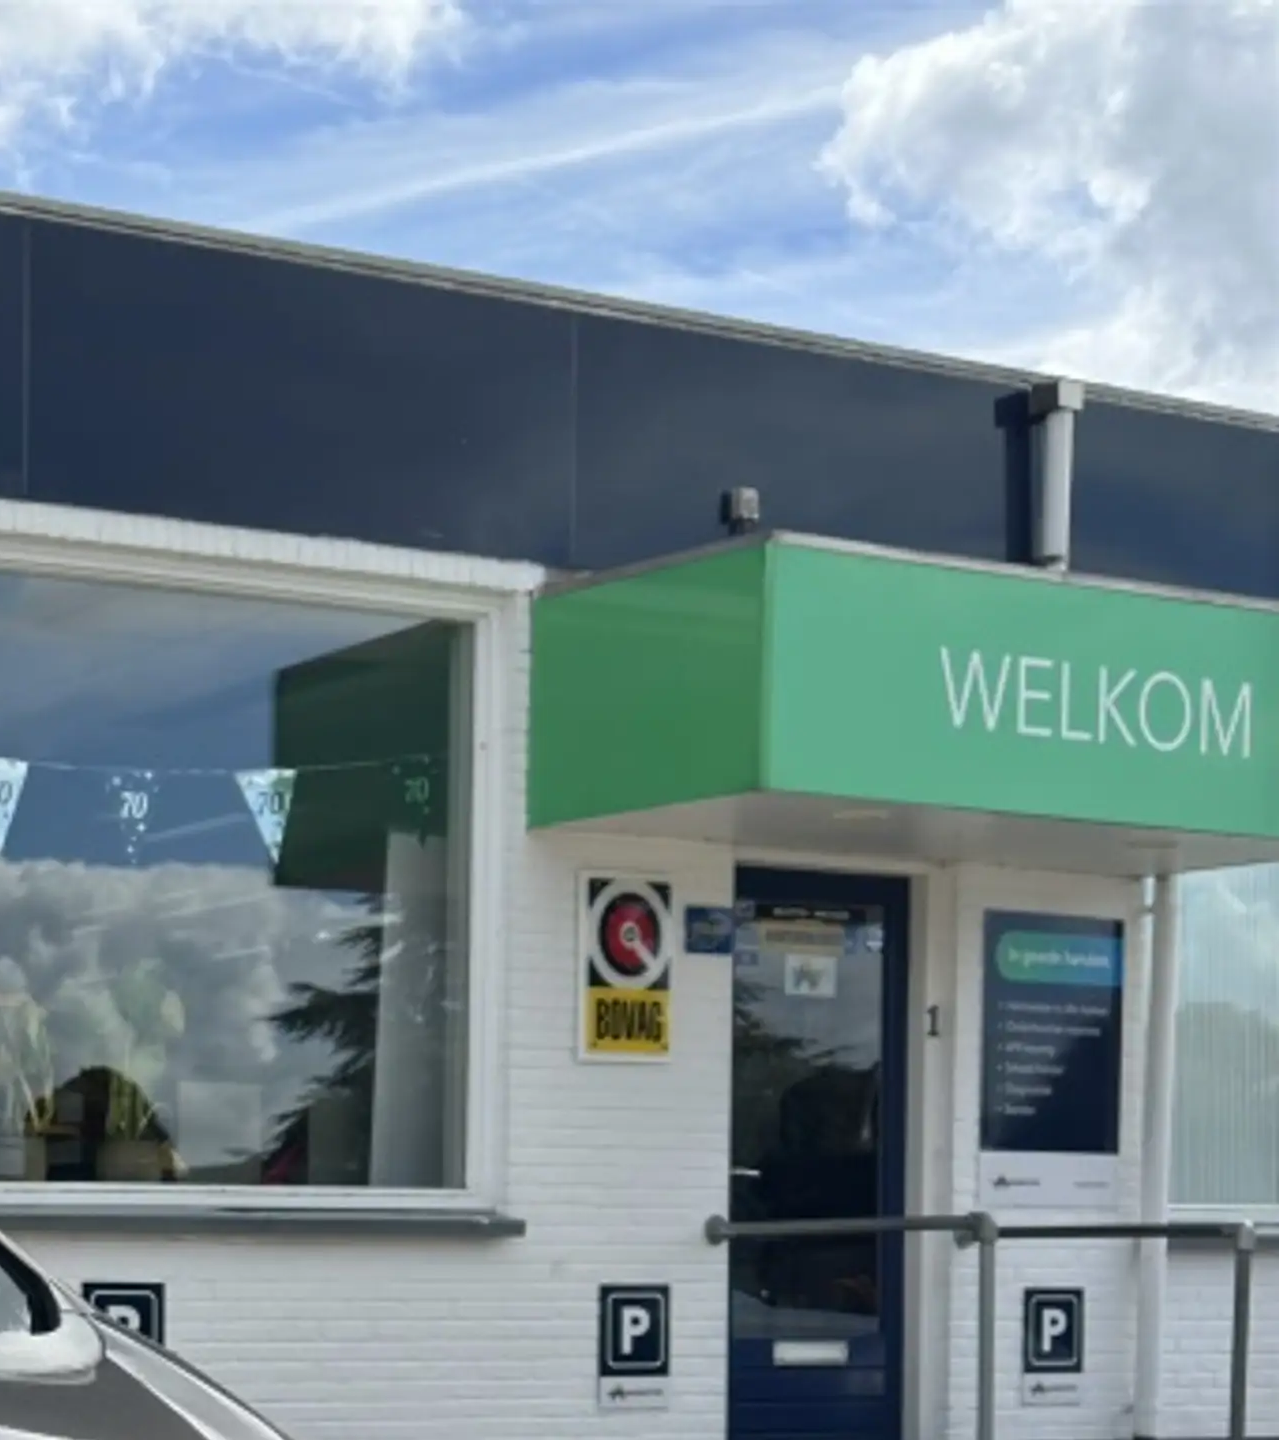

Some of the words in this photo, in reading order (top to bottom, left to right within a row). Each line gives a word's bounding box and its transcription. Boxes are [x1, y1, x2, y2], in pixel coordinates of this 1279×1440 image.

[940, 646, 1252, 758] WELKOM
[120, 791, 149, 819] 70
[256, 792, 285, 817] 70
[596, 997, 663, 1042] BOVAG
[926, 1005, 940, 1038] 1
[619, 1306, 651, 1355] P
[1042, 1307, 1067, 1353] P
